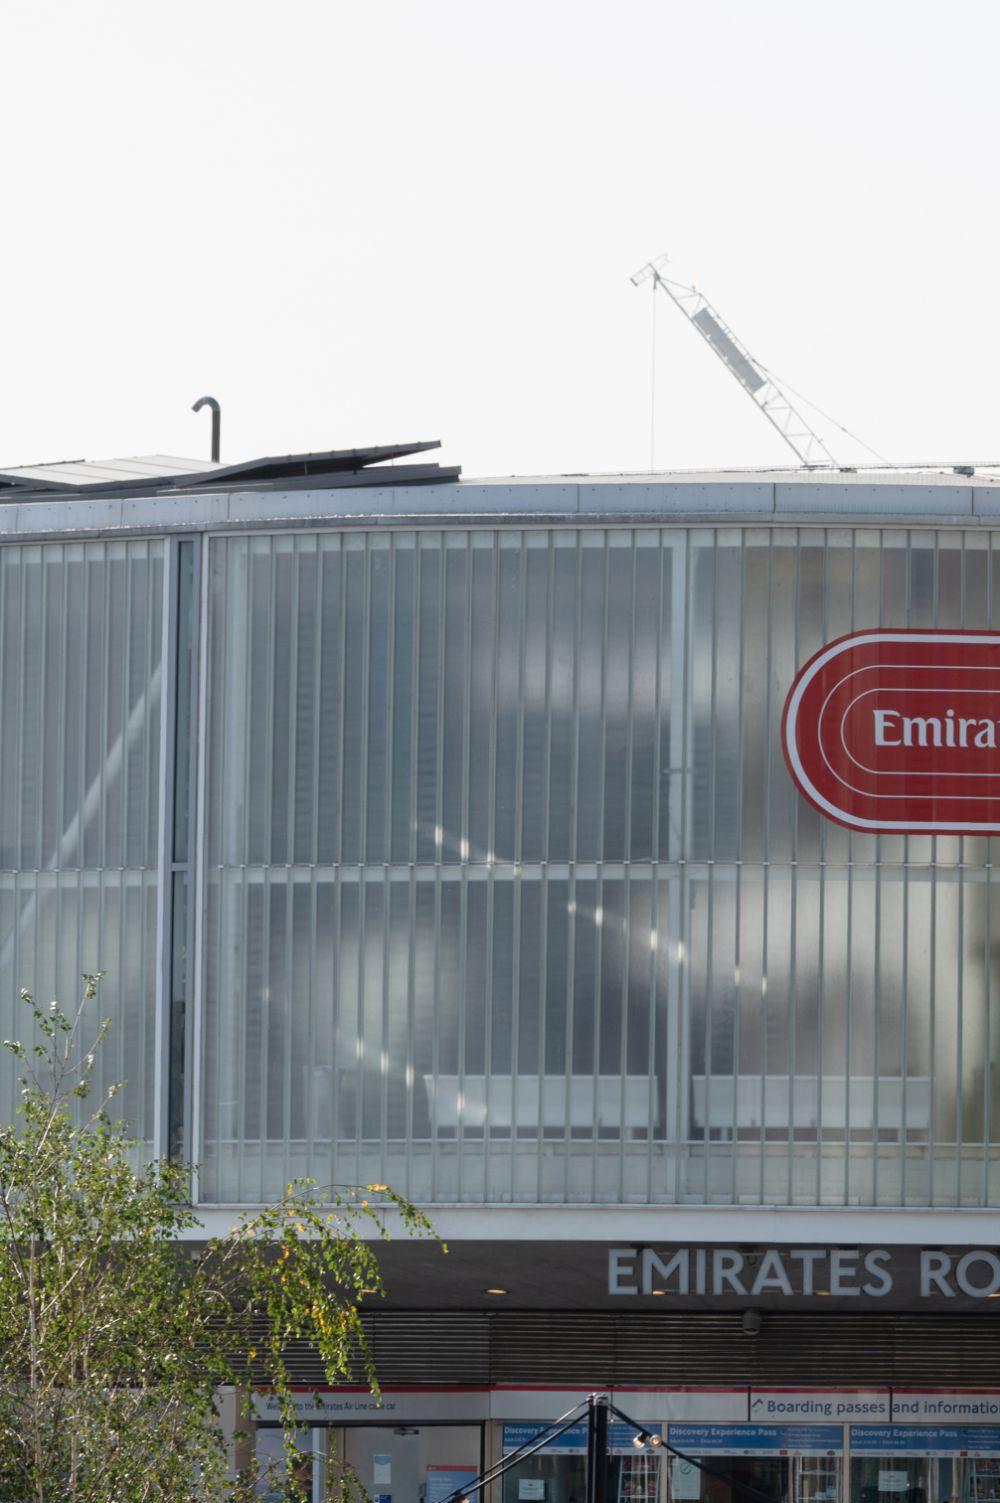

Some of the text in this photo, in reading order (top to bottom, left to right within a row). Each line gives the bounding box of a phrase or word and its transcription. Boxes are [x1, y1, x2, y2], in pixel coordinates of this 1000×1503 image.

[608, 1248, 893, 1297] EMIRATES
[767, 1399, 832, 1415] Boarding
[836, 1402, 886, 1416] passes
[892, 1401, 918, 1414] and
[504, 1426, 538, 1436] Discovery
[669, 1427, 776, 1438] Discovery Experience Pass
[851, 1429, 891, 1439] Discovery
[893, 1429, 938, 1440] Experience
[939, 1429, 958, 1438] Pass
